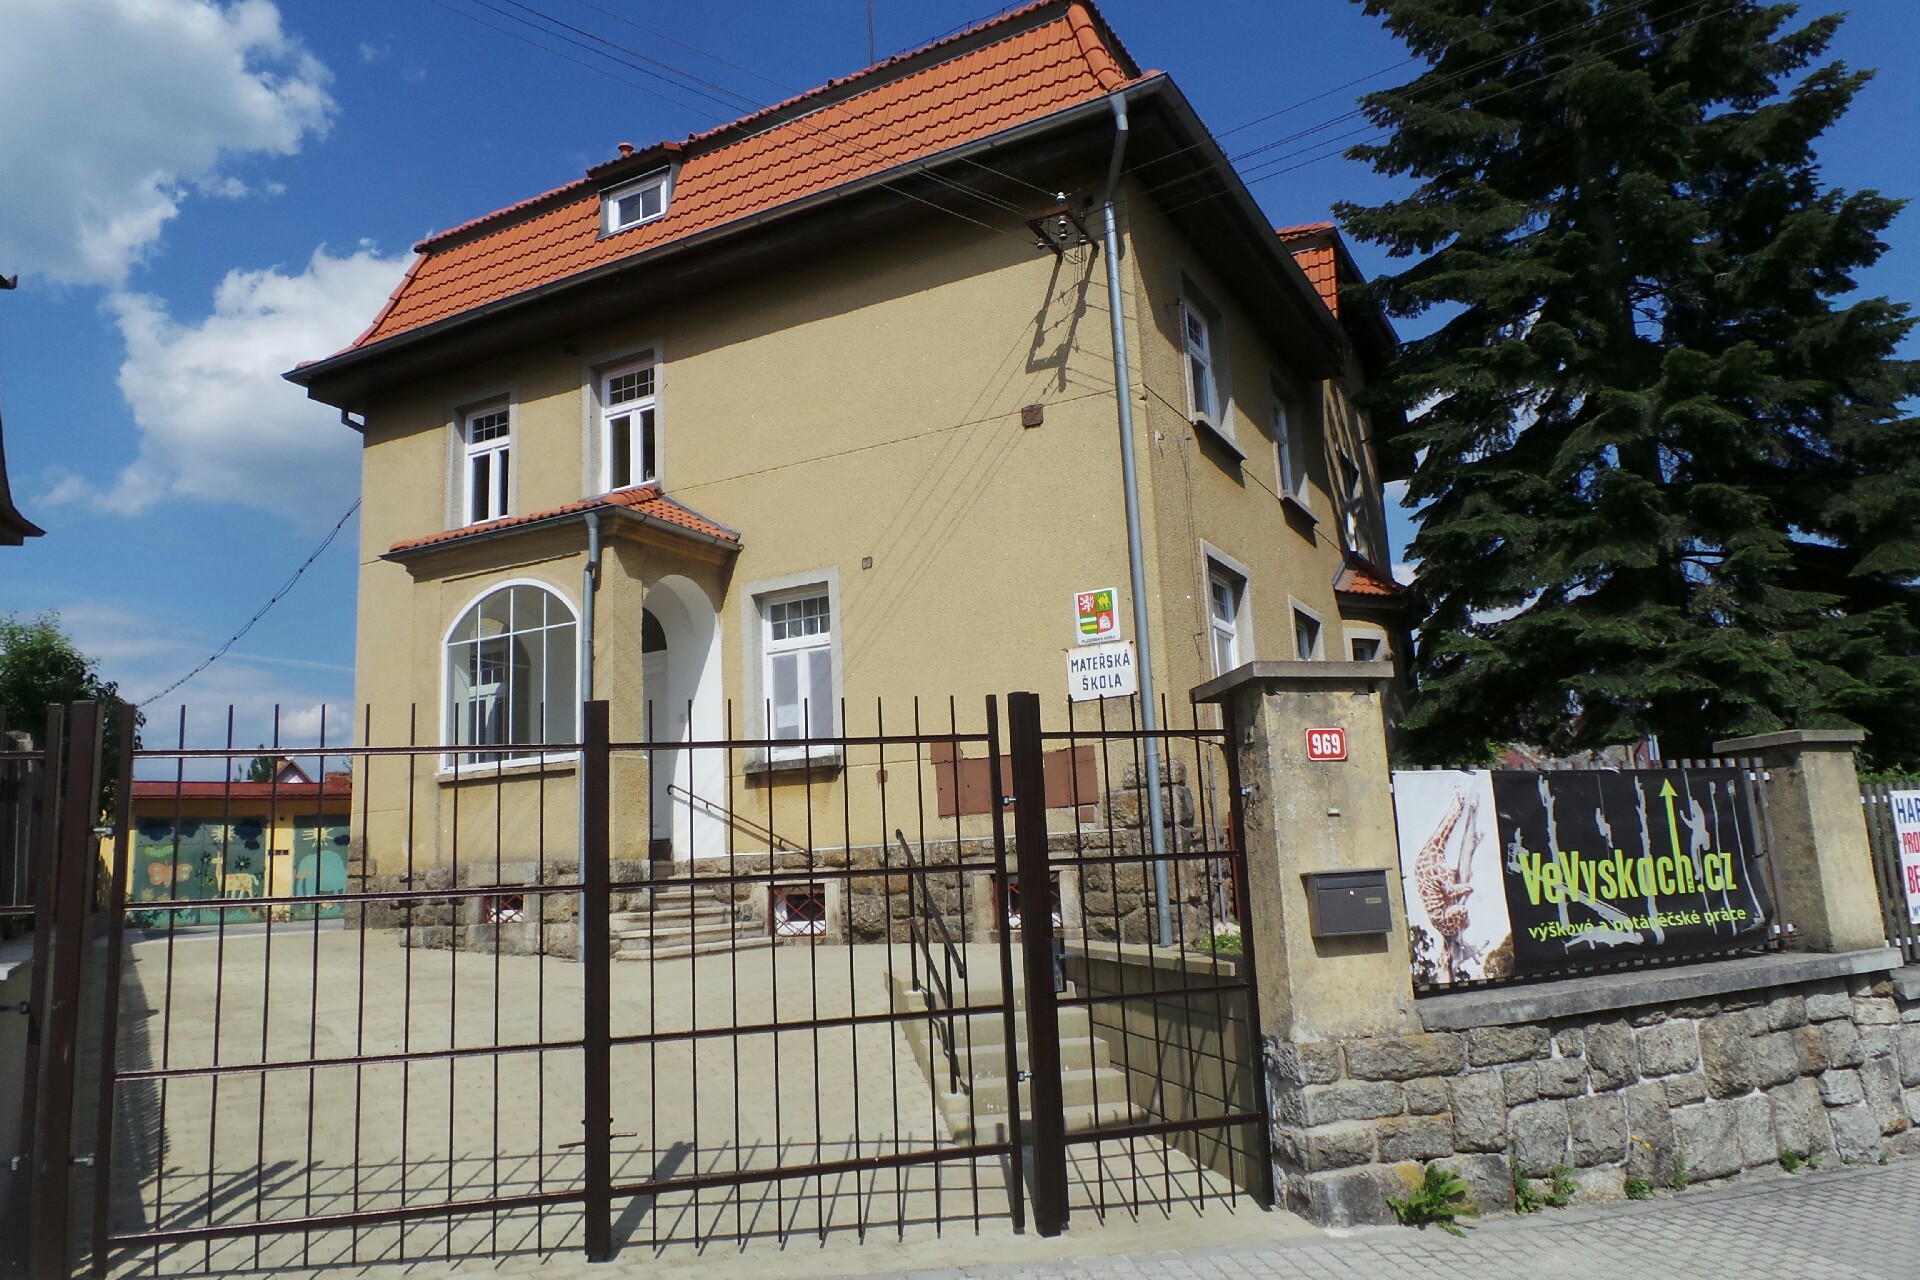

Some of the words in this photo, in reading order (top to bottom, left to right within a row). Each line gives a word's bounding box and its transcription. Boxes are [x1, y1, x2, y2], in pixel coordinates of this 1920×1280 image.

[1071, 649, 1131, 673] MATEŘSKÁ
[1082, 673, 1122, 691] ŠKOLA
[1312, 733, 1342, 755] 969
[1902, 831, 1920, 855] PRO
[1518, 848, 1738, 906] VeVyskach.cz
[1527, 917, 1595, 943] výškové
[1598, 921, 1610, 932] a
[1612, 909, 1701, 935] potápěčské
[1703, 907, 1747, 926] práce
